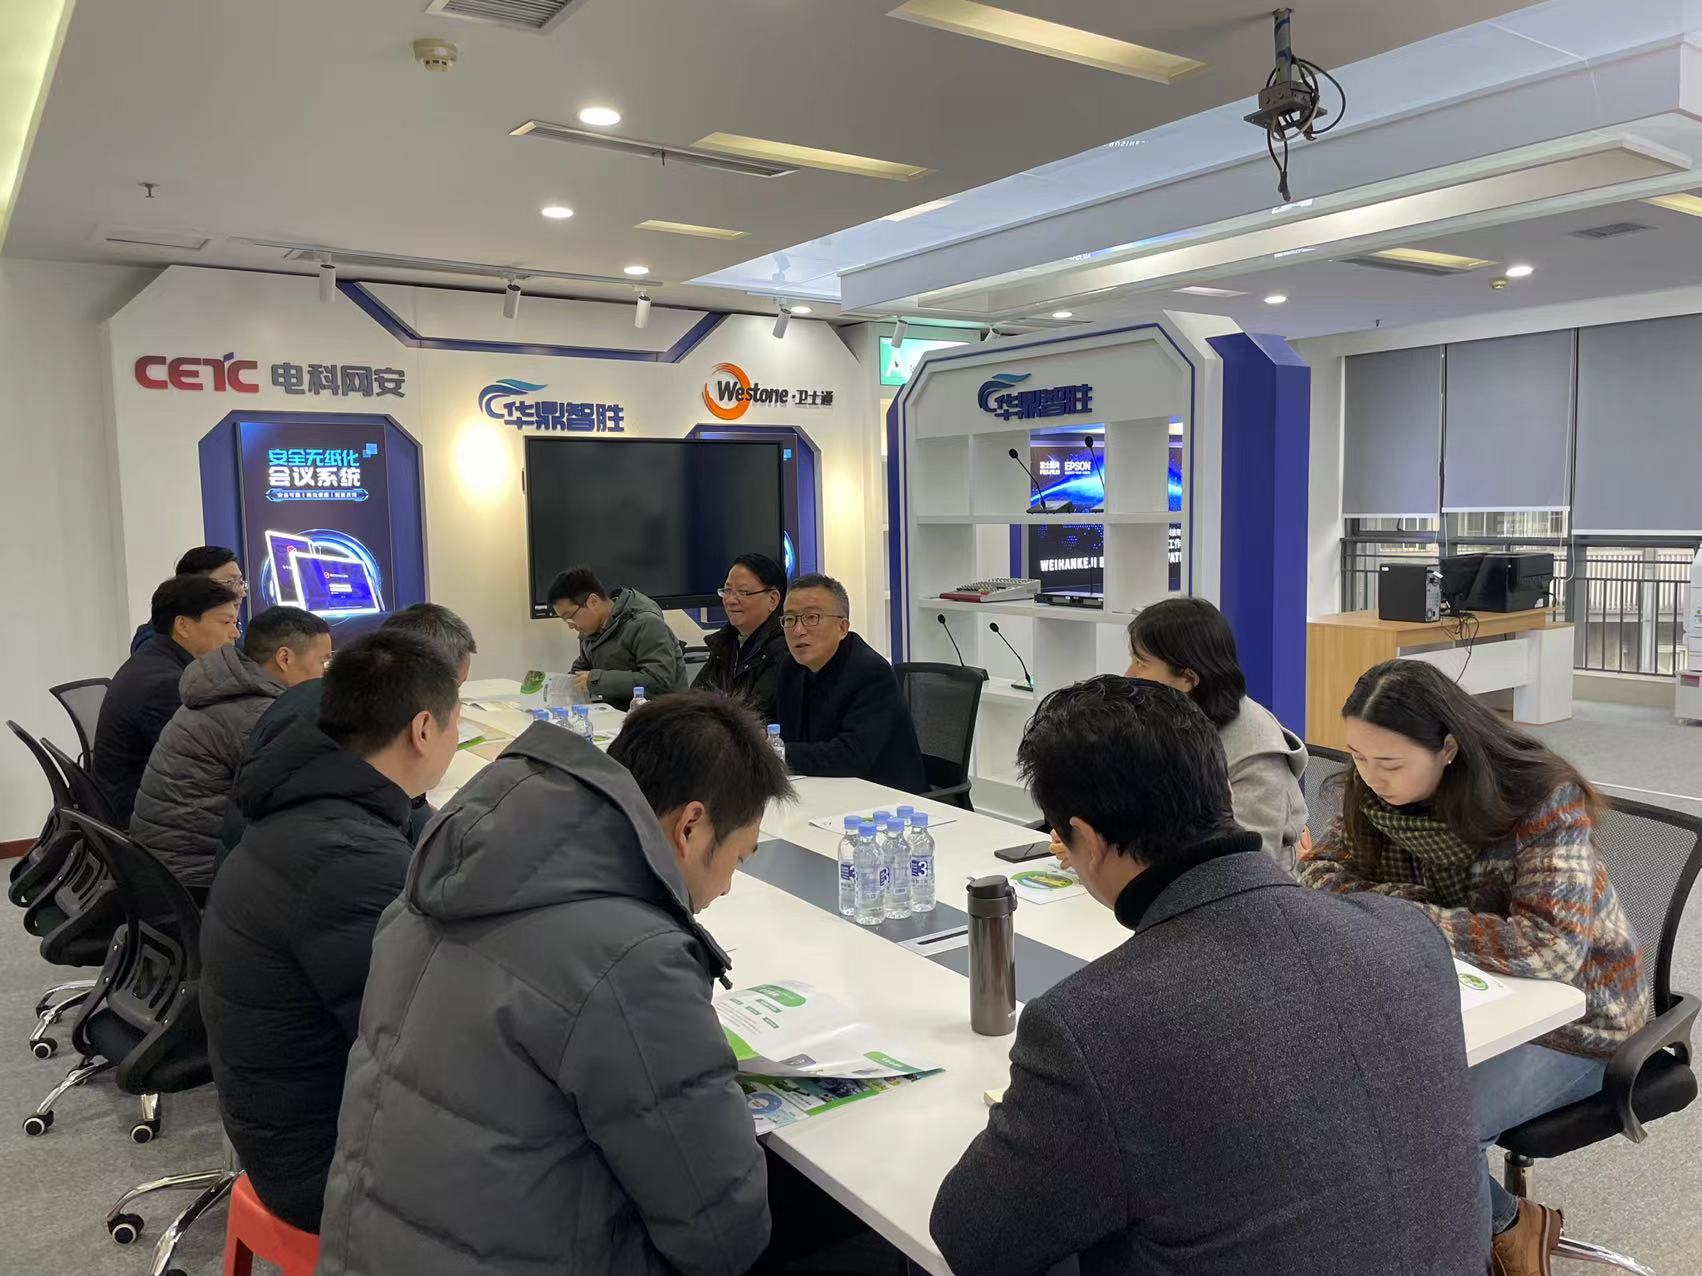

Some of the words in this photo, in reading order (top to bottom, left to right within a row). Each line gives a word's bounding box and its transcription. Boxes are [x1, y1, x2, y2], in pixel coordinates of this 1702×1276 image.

[135, 352, 259, 393] CETC
[271, 363, 406, 398] 电科网安
[717, 381, 788, 403] Westone
[995, 384, 1092, 420] 华鼎智胜
[504, 401, 624, 432] 华鼎智胜
[268, 449, 359, 466] 安全无纸化
[1064, 461, 1091, 471] EPSON
[268, 467, 360, 487] 会议系统
[1040, 556, 1097, 571] WEIHANKEJI
